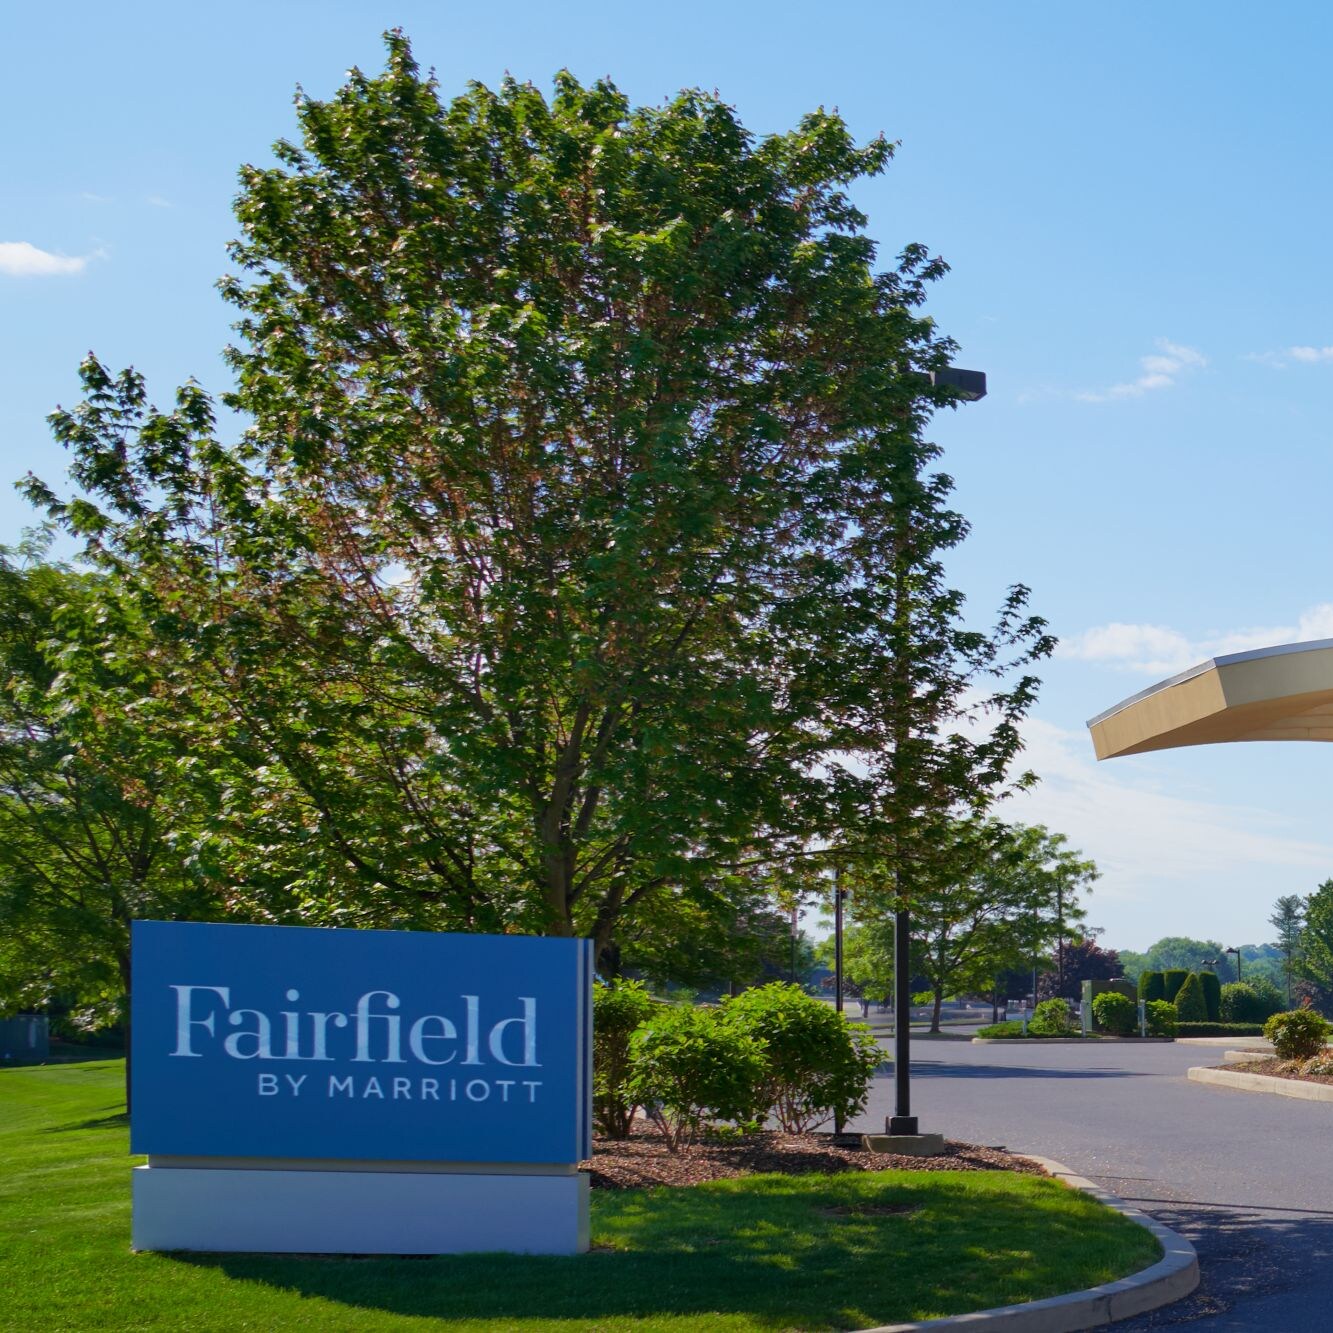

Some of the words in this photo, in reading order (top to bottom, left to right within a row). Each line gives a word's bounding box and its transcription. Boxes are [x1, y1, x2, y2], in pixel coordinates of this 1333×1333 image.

[169, 984, 543, 1068] Fairfield
[258, 1073, 308, 1097] BY
[328, 1075, 543, 1102] MARRIOTT
